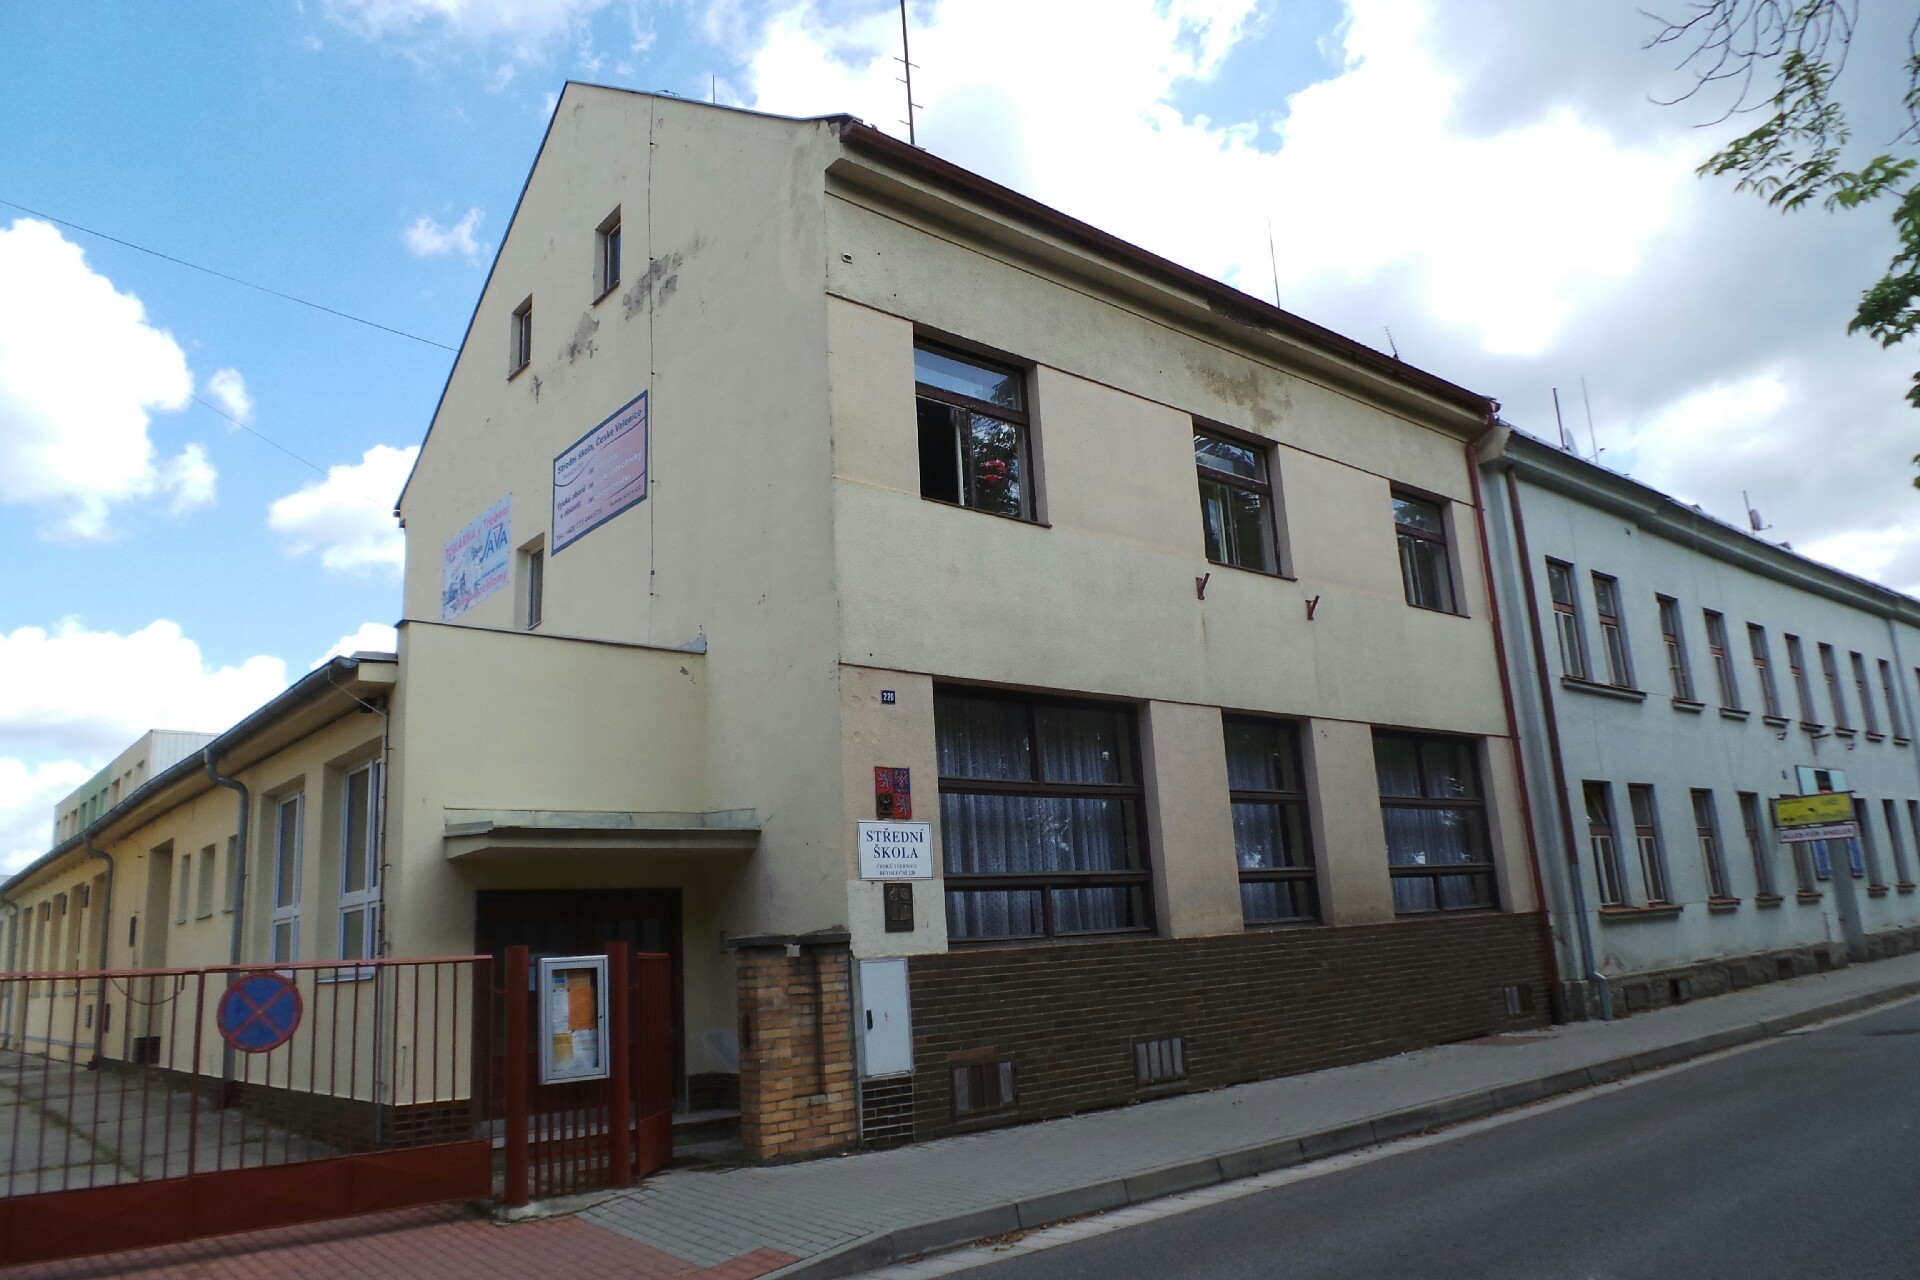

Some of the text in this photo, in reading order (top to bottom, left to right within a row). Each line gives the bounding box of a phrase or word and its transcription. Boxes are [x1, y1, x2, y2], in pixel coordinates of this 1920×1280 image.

[615, 409, 642, 431] Velenice
[866, 828, 924, 843] STŘEDNÍ
[873, 843, 919, 859] ŠKOLA
